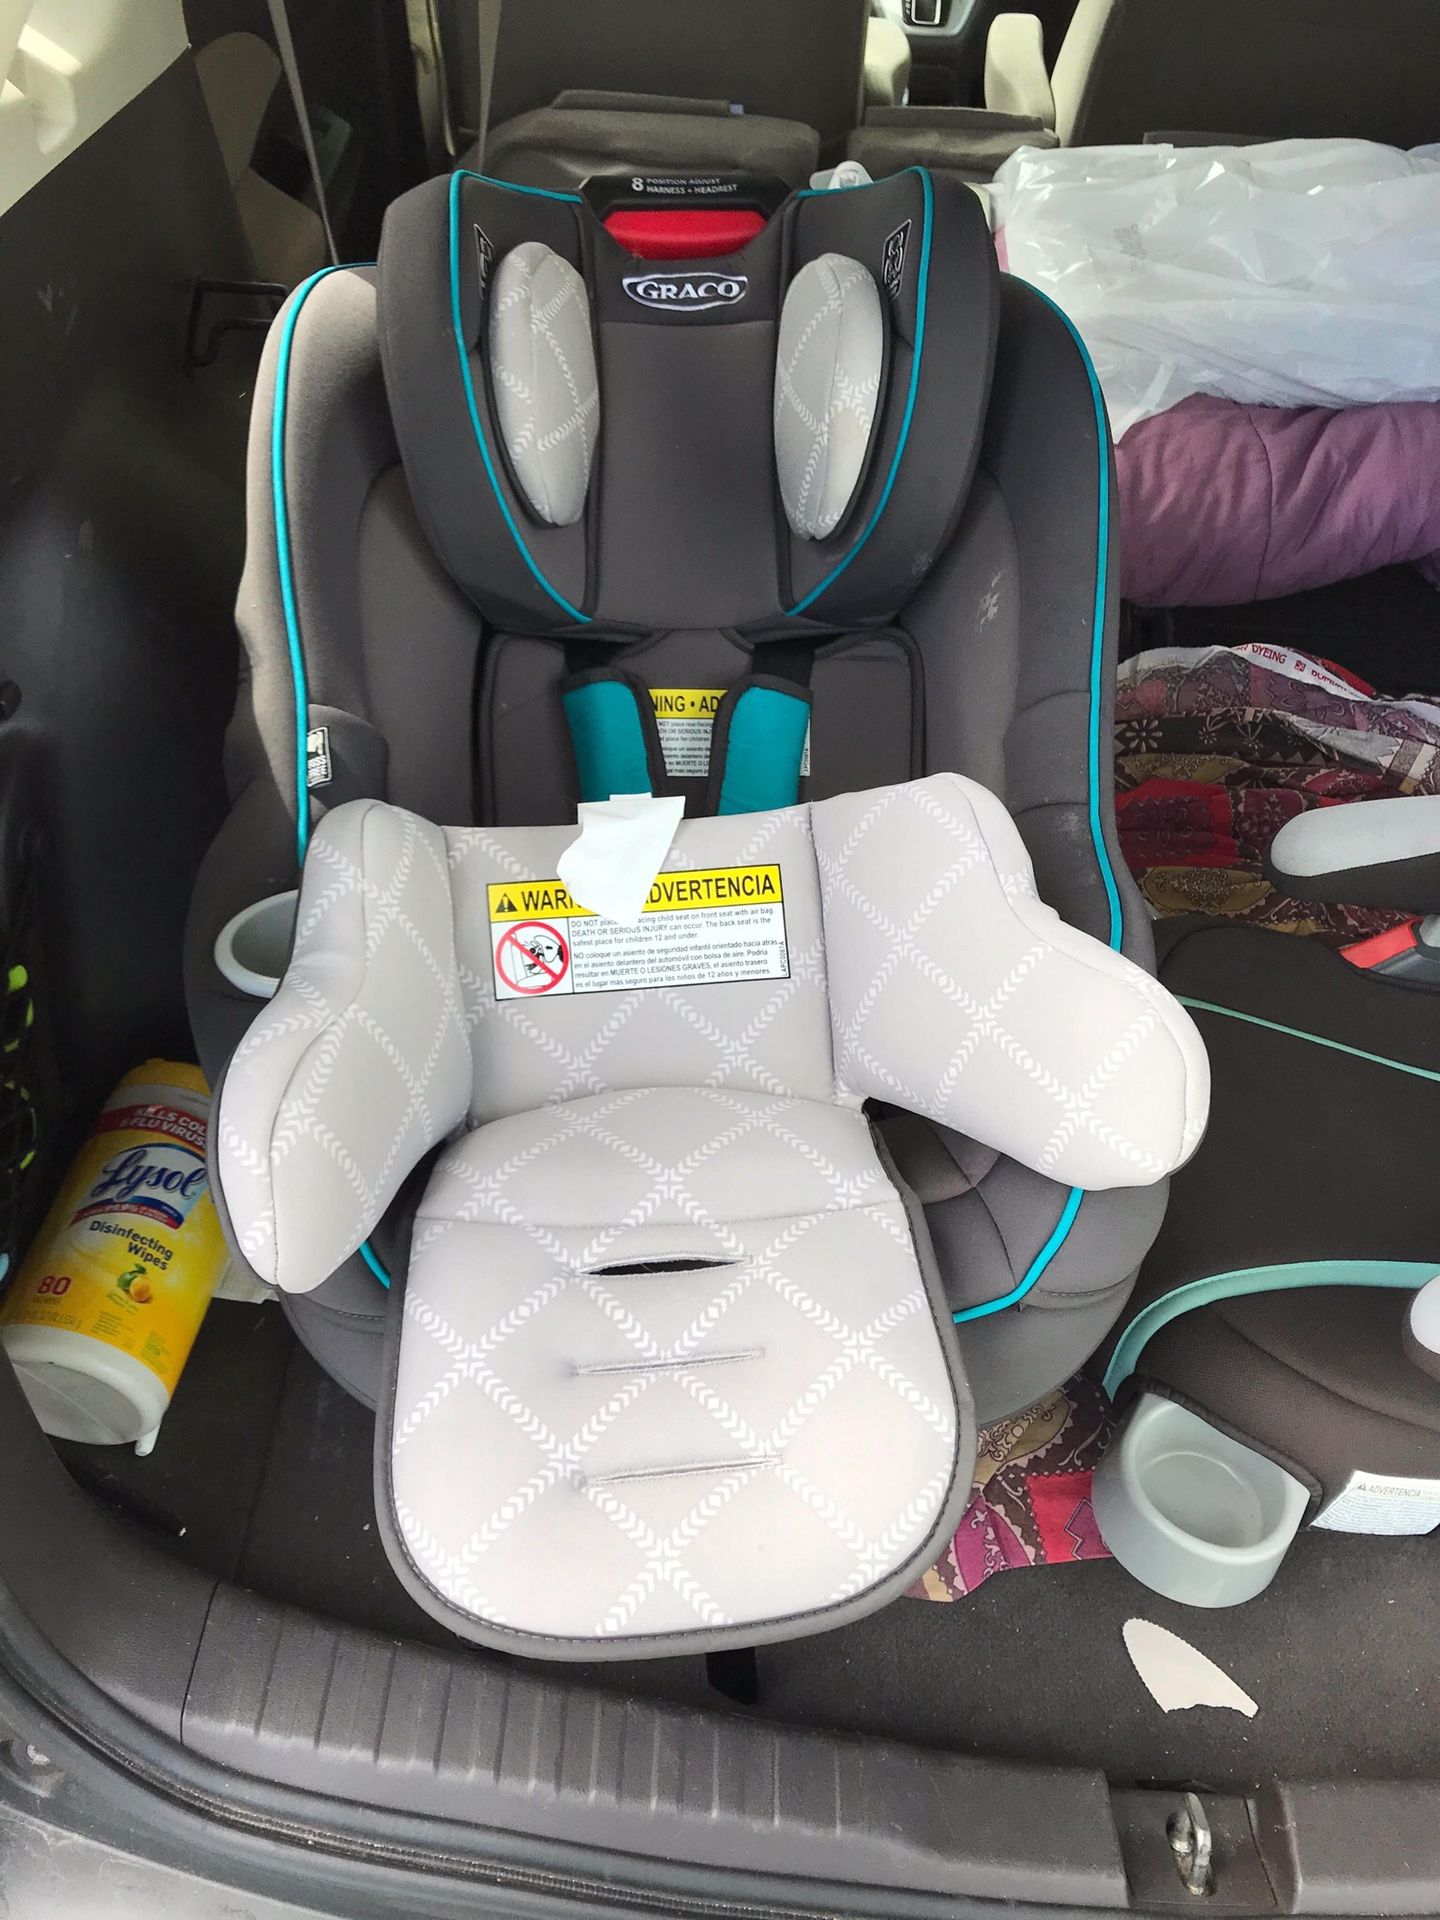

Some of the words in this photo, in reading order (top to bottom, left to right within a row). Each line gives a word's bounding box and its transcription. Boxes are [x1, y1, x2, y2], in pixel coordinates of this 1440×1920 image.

[631, 177, 644, 191] 8
[646, 185, 686, 194] HARNESS
[694, 184, 737, 194] HEADREST
[636, 281, 740, 299] GRACO
[1252, 644, 1287, 664] DYEING
[646, 874, 775, 905] DVERTENCIA
[571, 920, 581, 928] DO
[657, 914, 674, 922] child
[701, 911, 717, 919] front
[760, 907, 773, 915] bag
[571, 929, 595, 937] DEATH
[642, 924, 667, 932] INJURY
[719, 919, 735, 927] back
[572, 939, 593, 947] safest
[594, 938, 613, 946] place
[626, 935, 653, 943] children
[585, 951, 611, 960] coloque
[656, 945, 688, 955] seguridad
[689, 943, 711, 951] infantil
[712, 942, 742, 950] orientado
[591, 960, 614, 968] asiento
[616, 957, 645, 966] delantero
[647, 956, 657, 964] del
[703, 951, 721, 959] bolsa
[575, 970, 599, 978] resultar
[647, 964, 680, 973] LESIONES
[720, 960, 744, 968] asiento
[592, 980, 609, 988] lugar
[625, 976, 647, 985] seguro
[648, 976, 664, 984] para
[162, 1120, 207, 1146] VIRUS
[179, 1116, 207, 1135] COL
[91, 1149, 207, 1199] Lysol
[89, 1220, 173, 1260] Disinfecting
[128, 1242, 168, 1271] Wipes
[37, 1276, 72, 1296] 80
[1368, 1485, 1421, 1497] ADVERTENCIA
